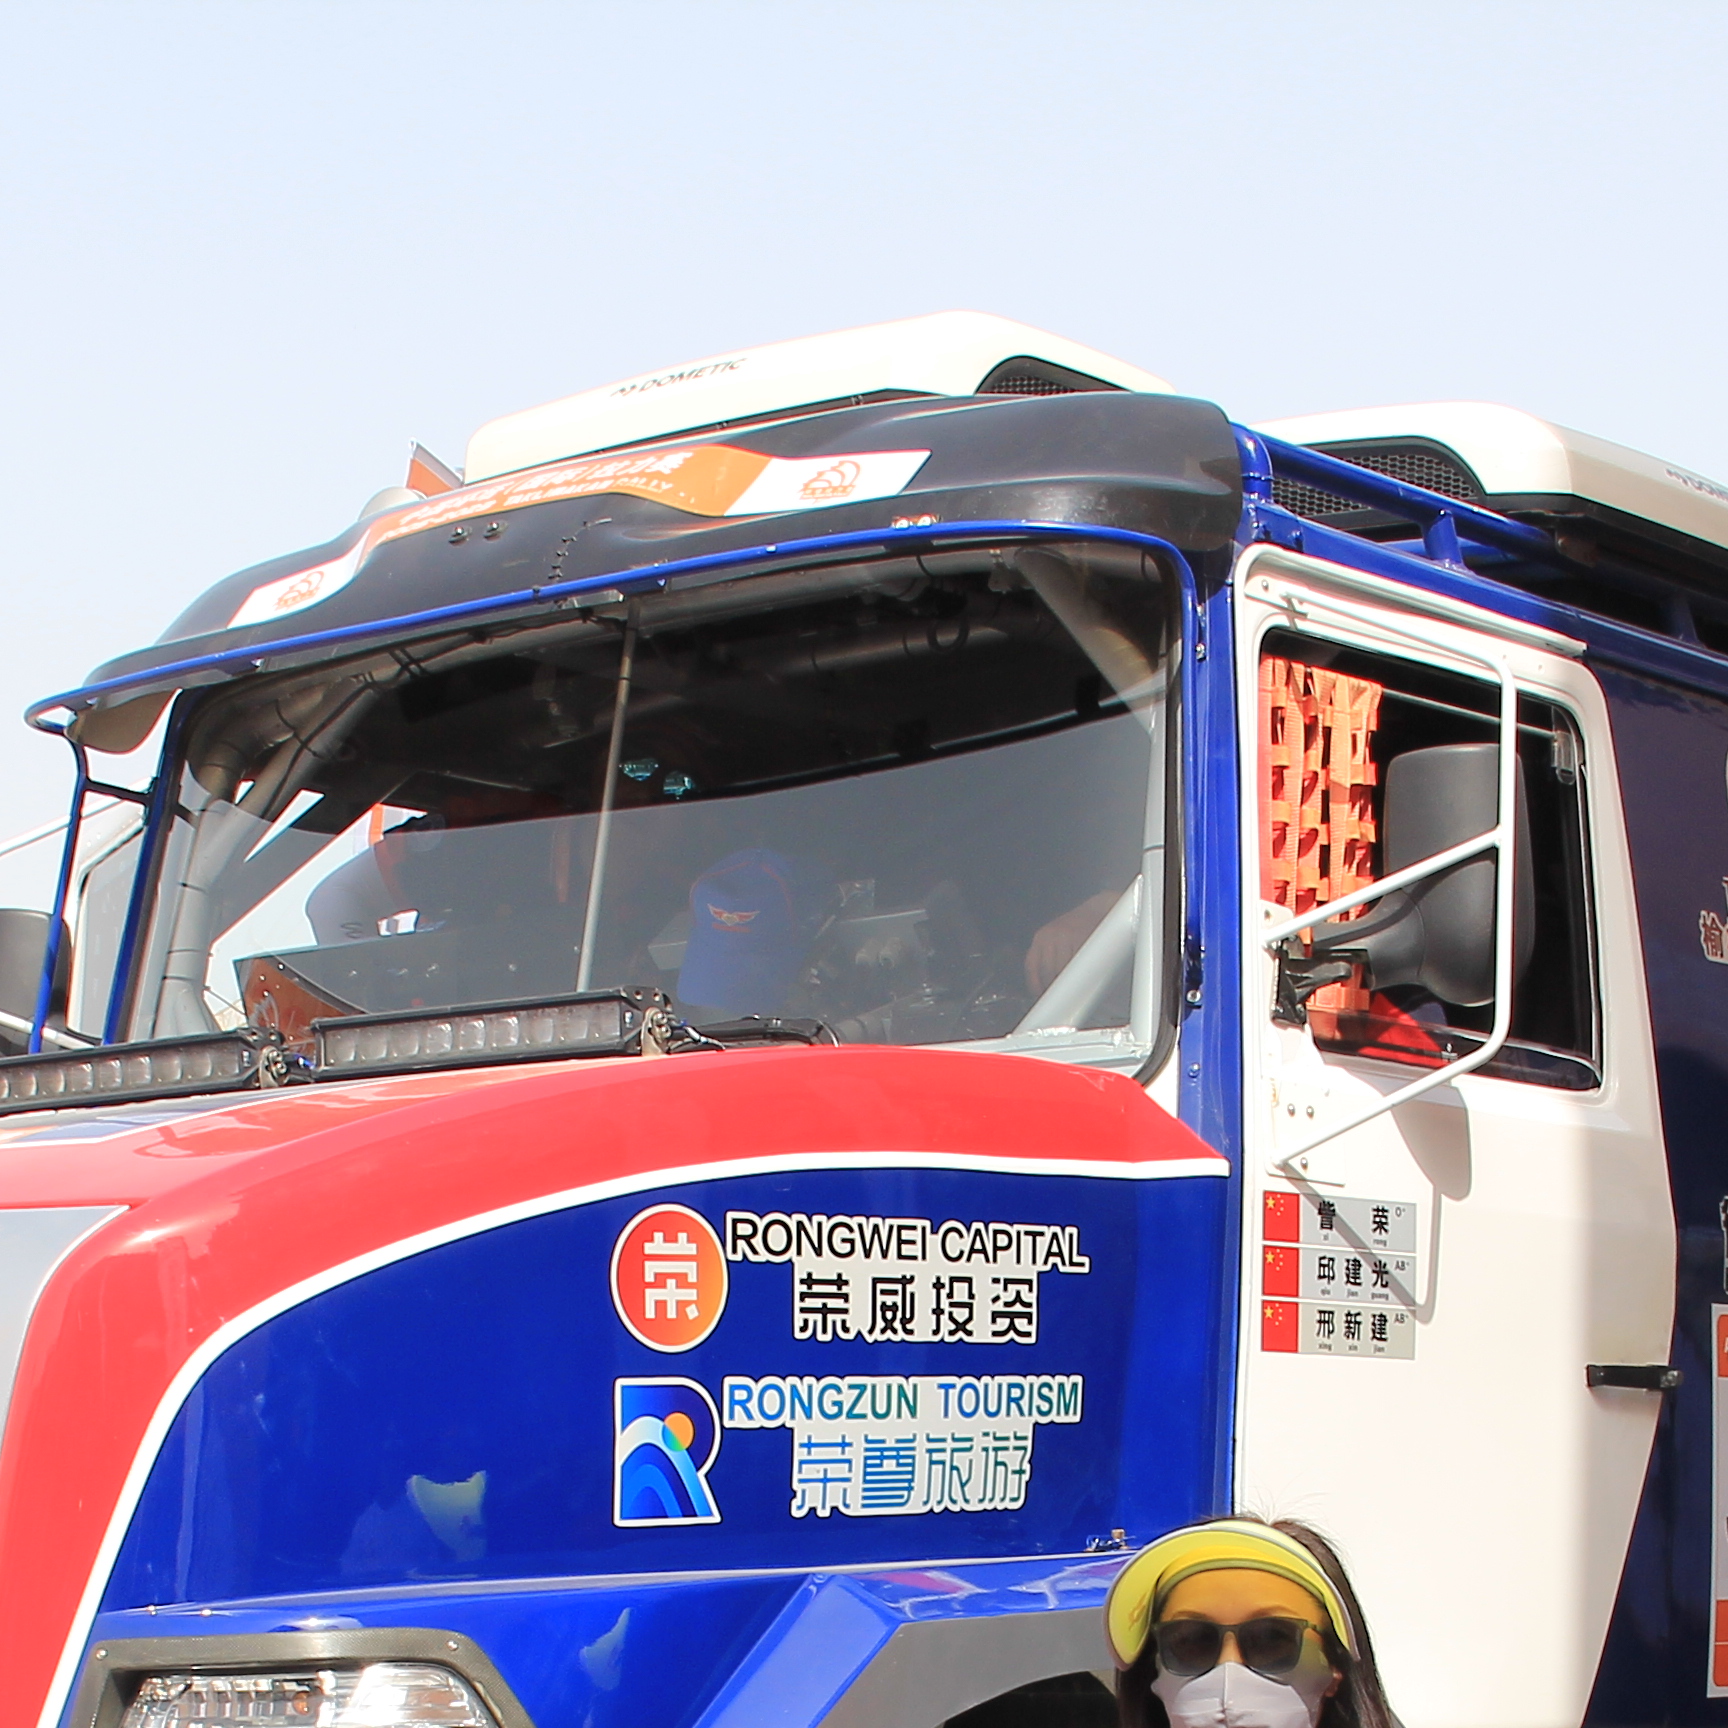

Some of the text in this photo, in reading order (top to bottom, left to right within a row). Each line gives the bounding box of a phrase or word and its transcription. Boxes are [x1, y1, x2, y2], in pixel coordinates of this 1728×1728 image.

[638, 357, 748, 393] DOMETIC
[730, 1216, 1089, 1269] RONGWEI CAPITAL
[799, 1271, 1036, 1339] 荣威投资
[728, 1380, 1080, 1421] RONGZUN TOURISM
[795, 1432, 1031, 1512] 荣尊旅游
